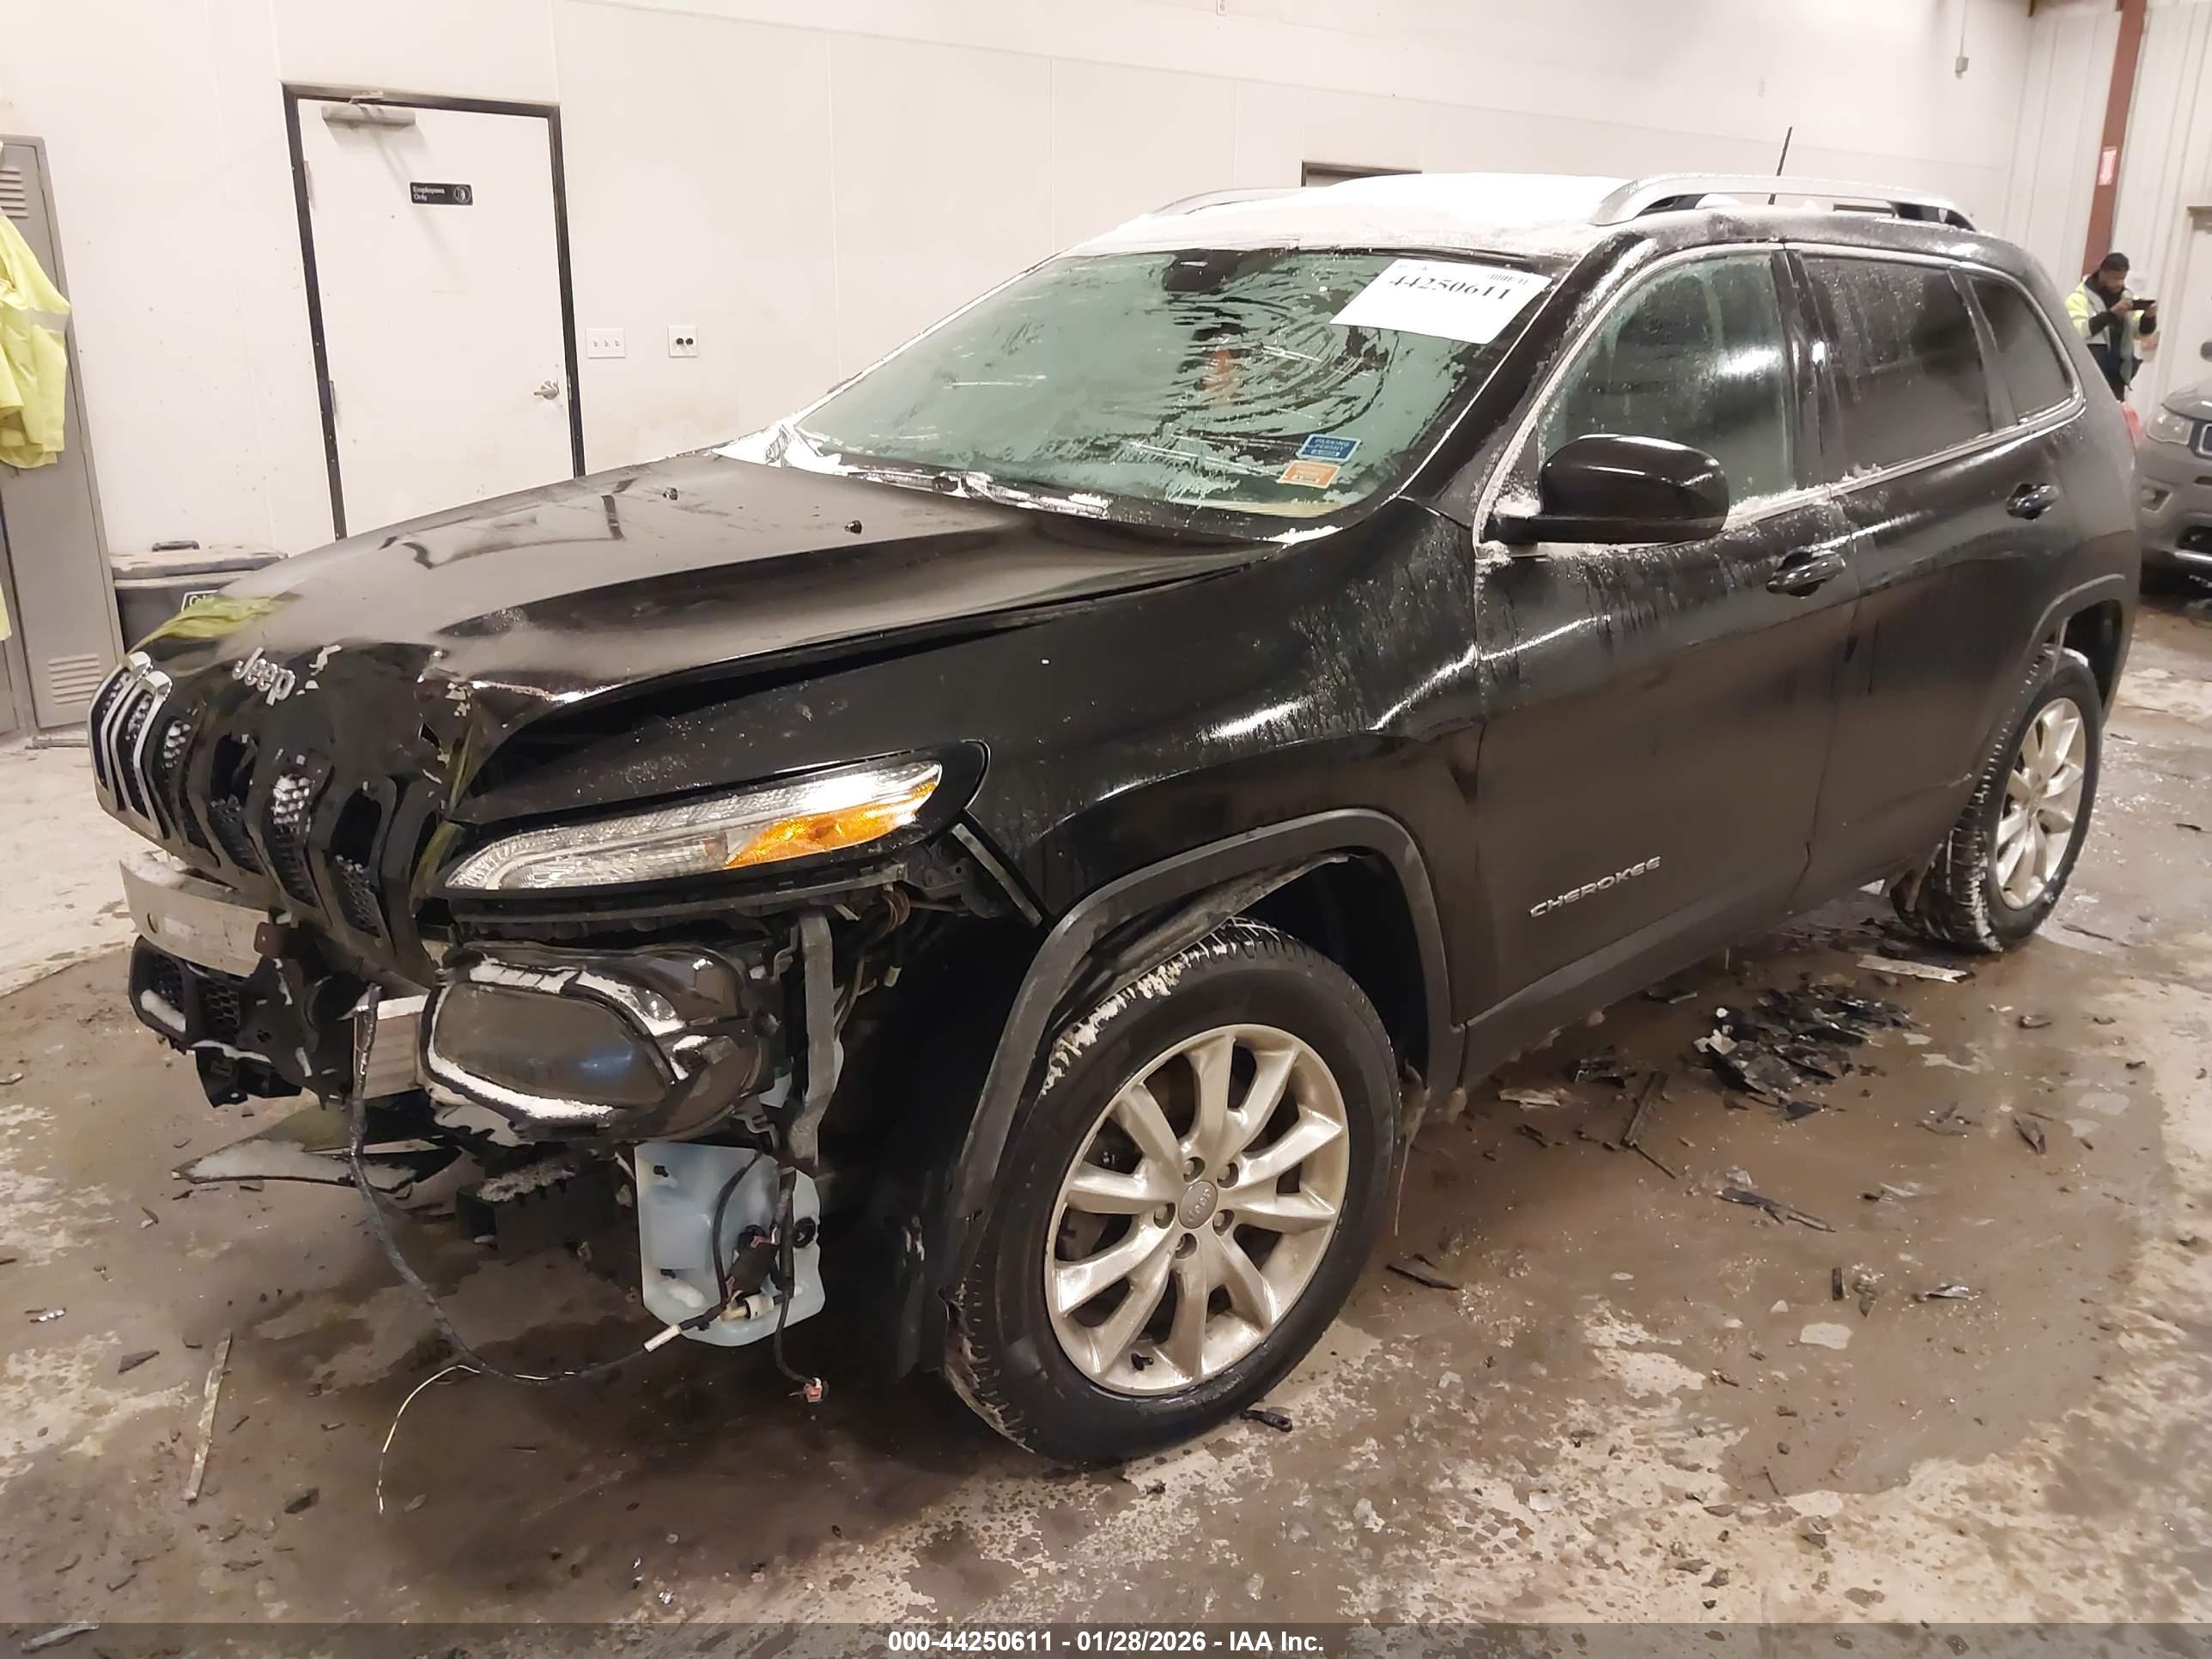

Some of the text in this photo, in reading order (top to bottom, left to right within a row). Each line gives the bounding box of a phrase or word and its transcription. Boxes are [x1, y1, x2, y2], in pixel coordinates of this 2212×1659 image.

[412, 185, 446, 194] Employees
[413, 193, 428, 202] Only
[1389, 275, 1512, 300] 44250611
[1315, 438, 1350, 447] PARKING
[232, 646, 296, 707] Jeep
[1530, 855, 1662, 918] CHEROKEE
